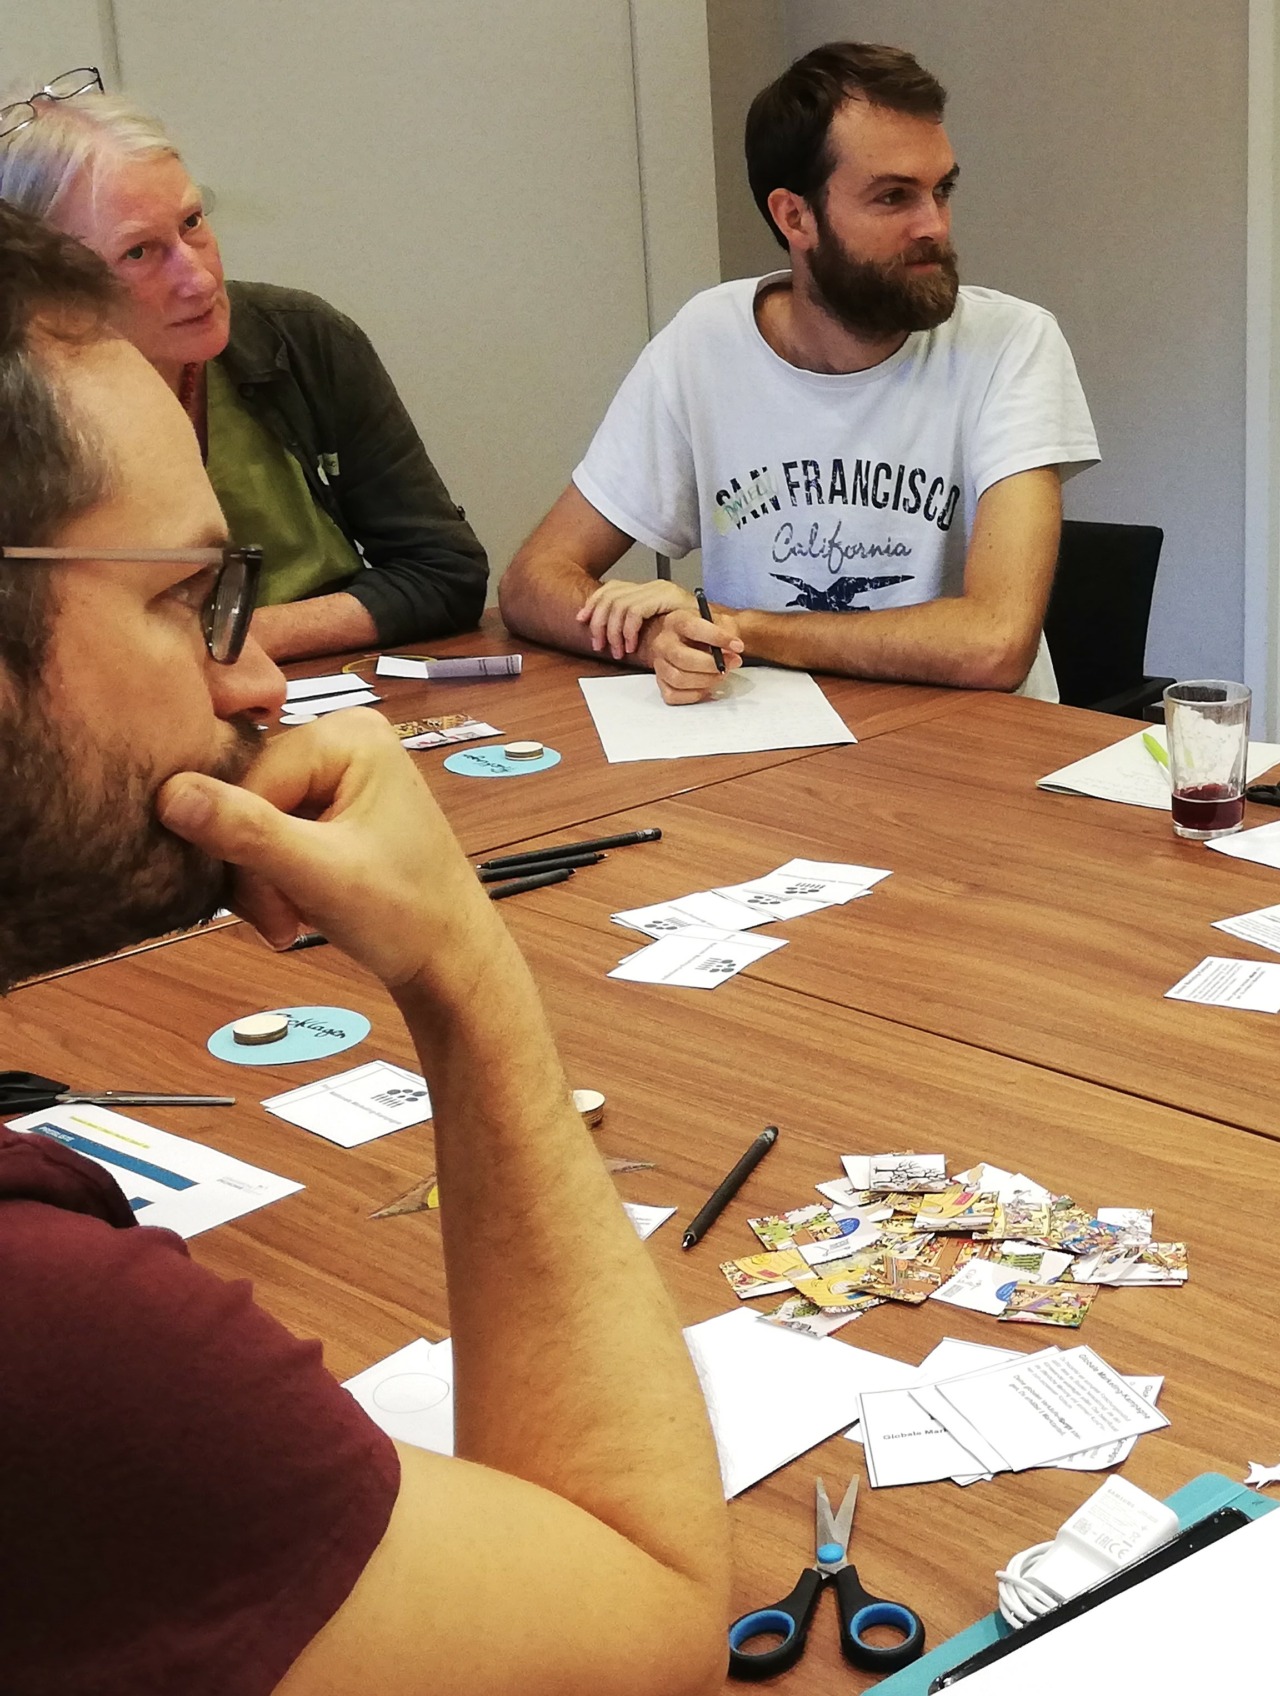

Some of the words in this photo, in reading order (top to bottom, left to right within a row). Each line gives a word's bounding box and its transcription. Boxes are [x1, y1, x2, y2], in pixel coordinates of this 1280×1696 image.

[782, 459, 960, 531] FRANCISCO
[772, 519, 912, 574] California
[275, 1013, 347, 1039] cklagen
